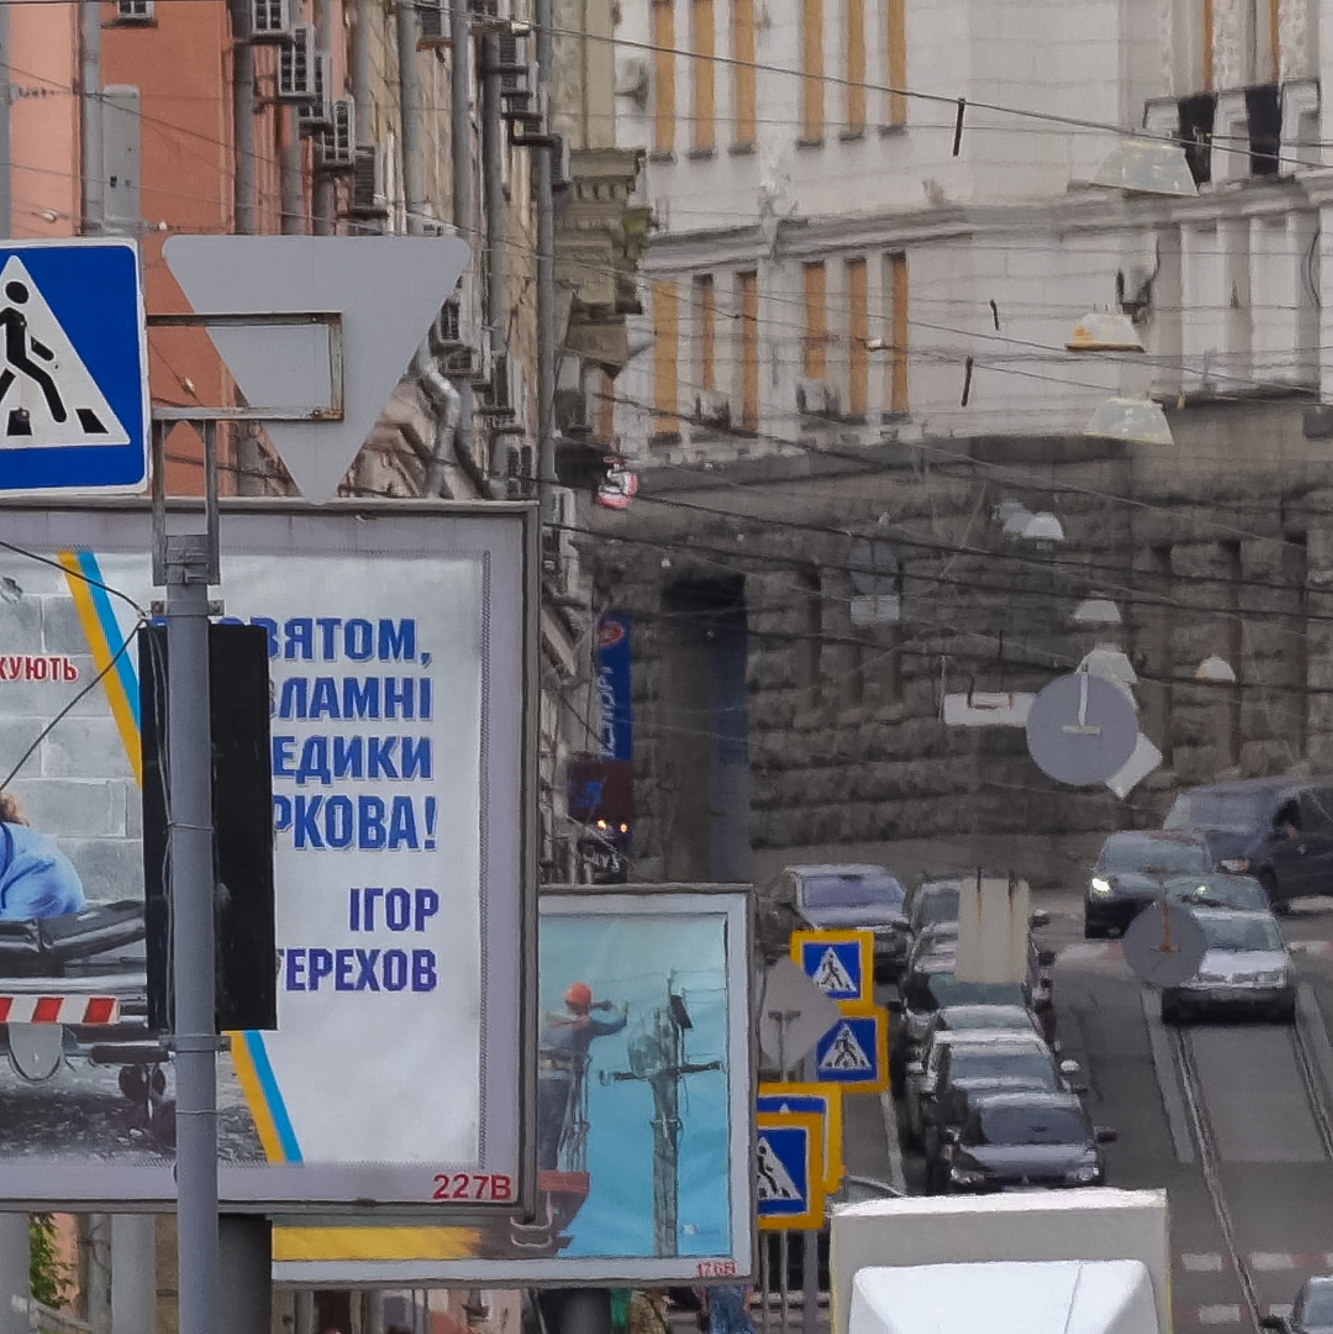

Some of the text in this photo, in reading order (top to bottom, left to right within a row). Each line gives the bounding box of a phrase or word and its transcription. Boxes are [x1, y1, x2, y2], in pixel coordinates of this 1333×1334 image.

[217, 617, 432, 666] ВЯТОМ,
[269, 677, 433, 720] ЛАМНІ
[273, 736, 433, 785] ЕДИКИ
[273, 795, 437, 850] РКОВА!
[349, 887, 439, 932] ІГОР
[275, 948, 438, 993] ЕРЕХОВ
